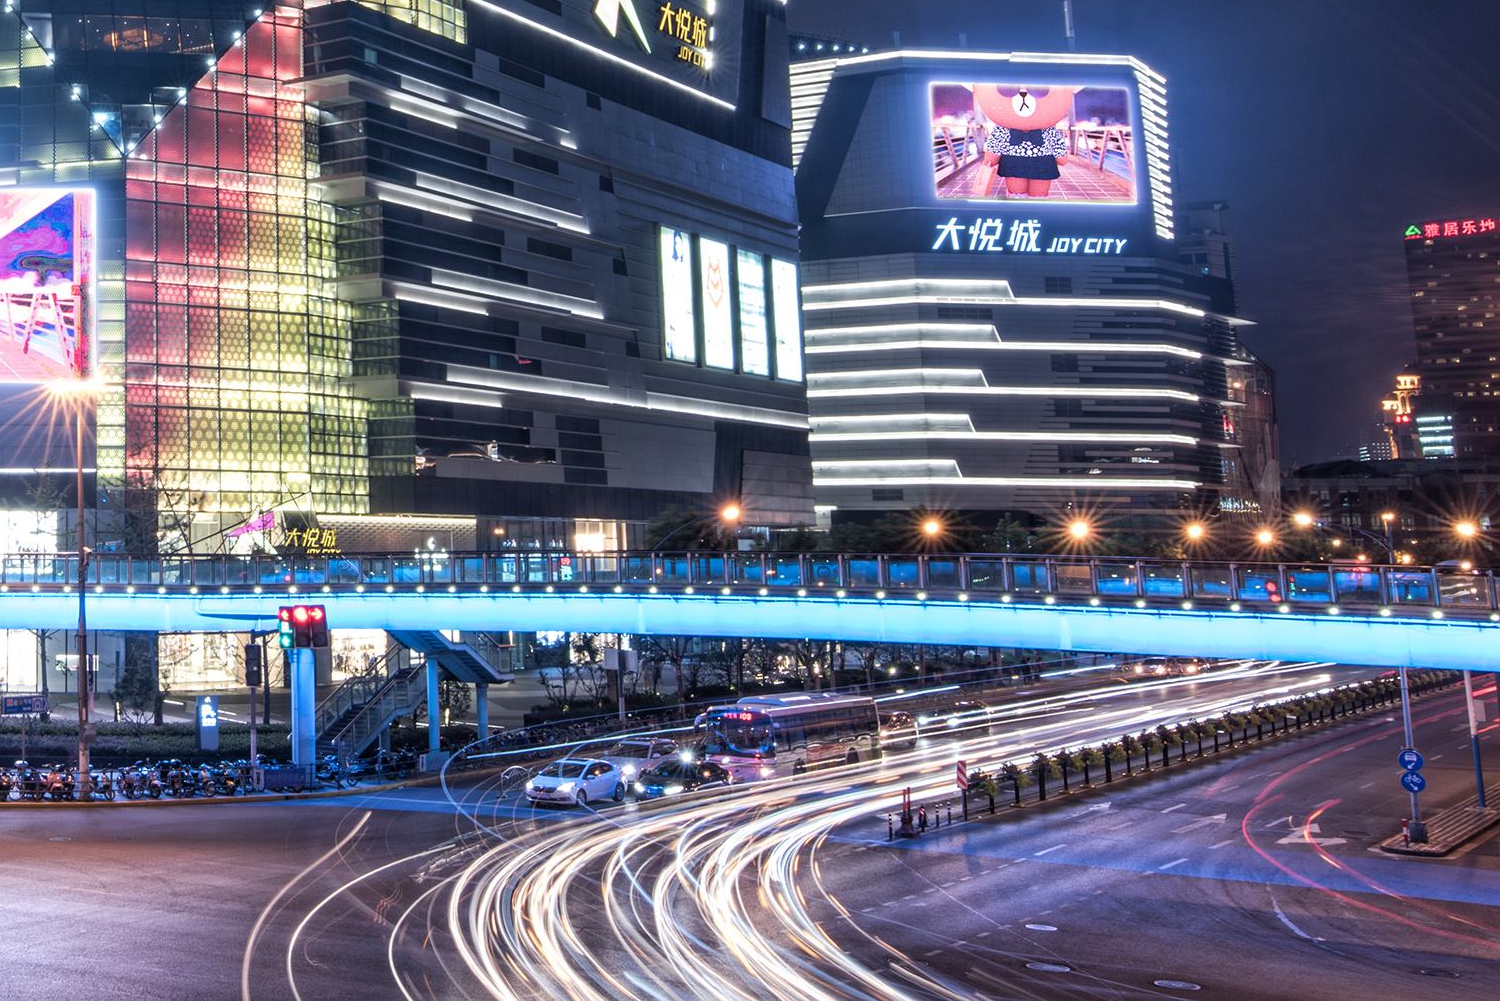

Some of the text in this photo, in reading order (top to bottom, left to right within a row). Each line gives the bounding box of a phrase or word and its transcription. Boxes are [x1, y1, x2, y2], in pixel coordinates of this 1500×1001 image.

[659, 2, 707, 48] 大悦城
[677, 46, 692, 62] JOY
[932, 217, 1127, 254] 大悦城 JOY CITY
[1424, 218, 1500, 238] 雅居乐地
[284, 528, 337, 547] 大悦城
